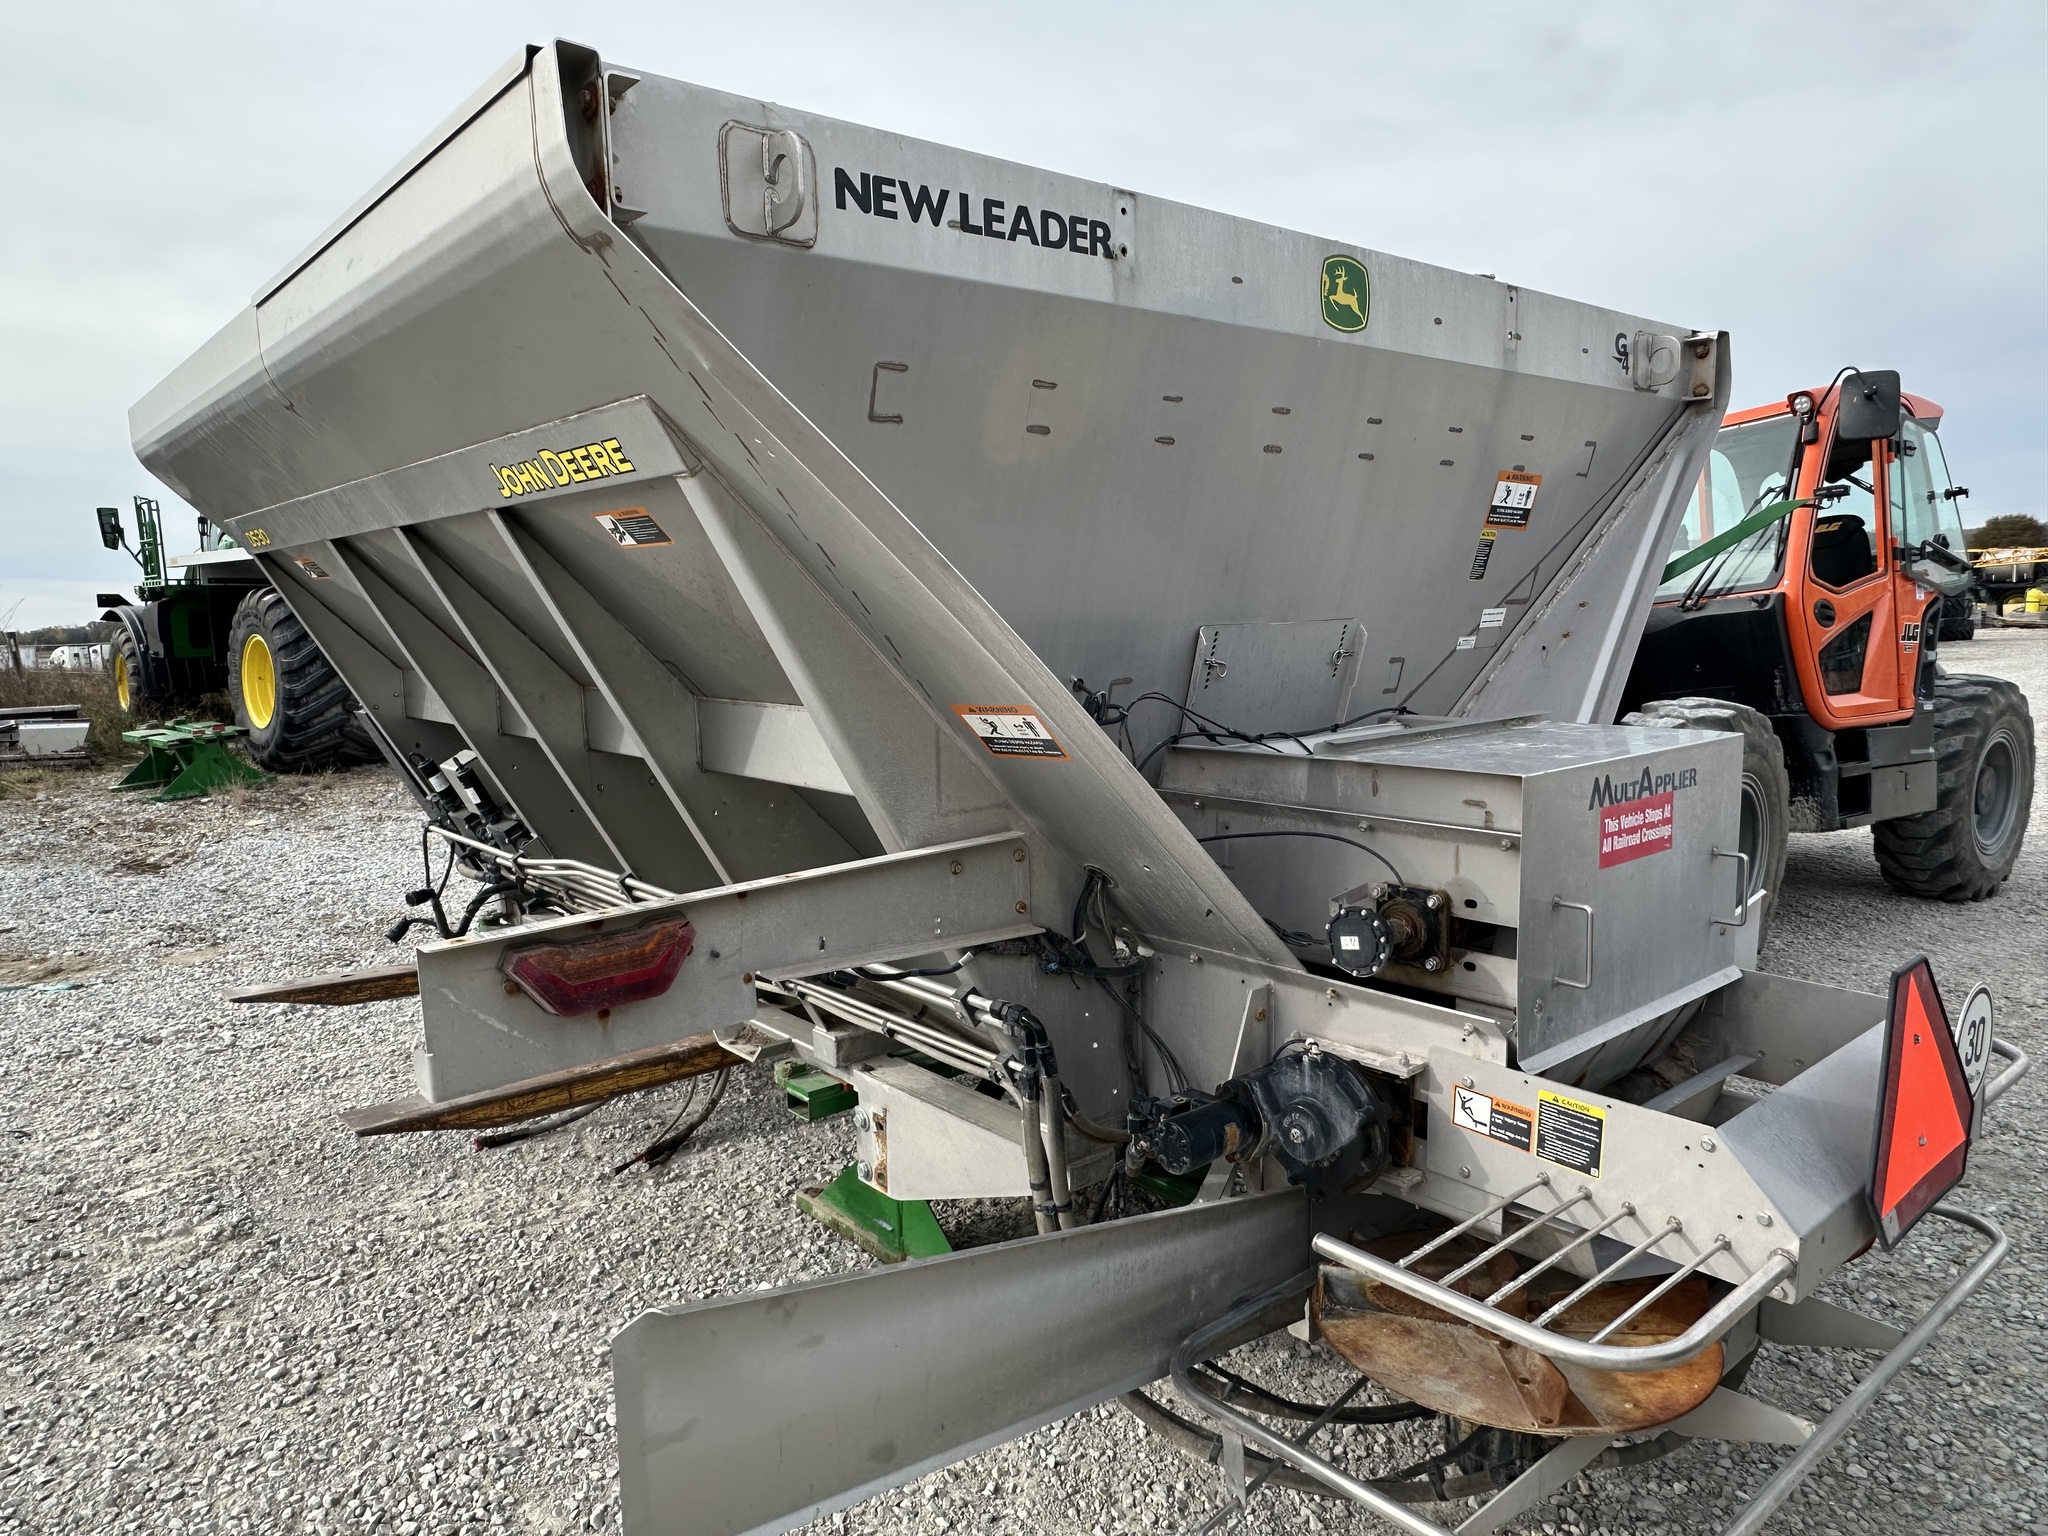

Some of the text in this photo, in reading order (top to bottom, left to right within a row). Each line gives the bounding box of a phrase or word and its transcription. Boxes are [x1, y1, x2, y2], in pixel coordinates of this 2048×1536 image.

[834, 167, 1114, 259] NEW LEADER
[489, 437, 636, 498] JOHN DEERE
[1900, 622, 1920, 643] JLG
[1605, 803, 1671, 834] This Vehicle Stops At
[1602, 824, 1672, 854] All Railroad Crossings
[1965, 1016, 1985, 1067] 30
[1561, 1099, 1590, 1113] CAUTION
